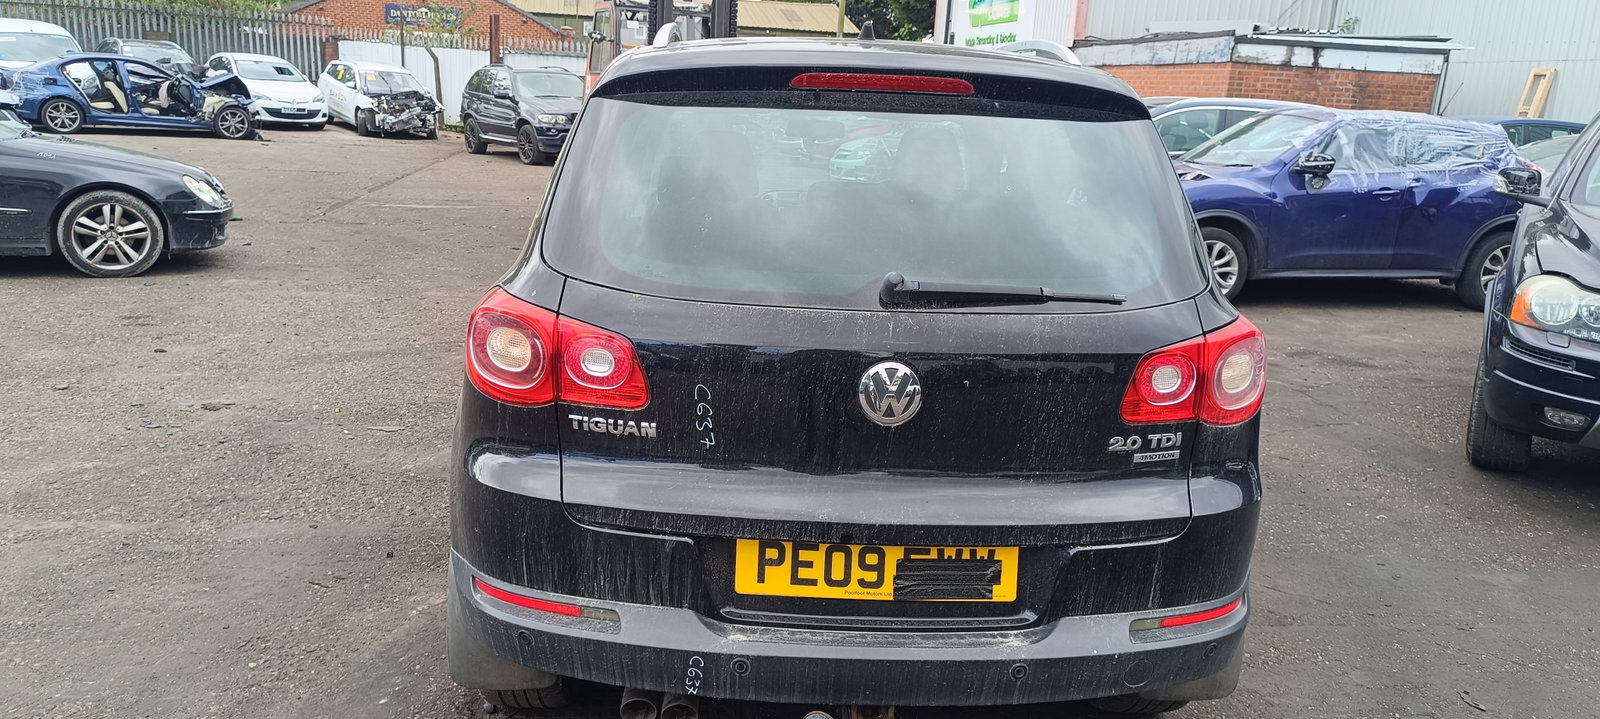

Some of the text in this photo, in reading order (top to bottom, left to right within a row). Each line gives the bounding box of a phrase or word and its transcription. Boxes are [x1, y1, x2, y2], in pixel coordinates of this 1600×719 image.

[568, 414, 657, 438] TIGUAN
[695, 384, 715, 449] C637
[1138, 452, 1176, 461] 4MOTION
[757, 541, 887, 590] PE09
[685, 655, 704, 695] C637
